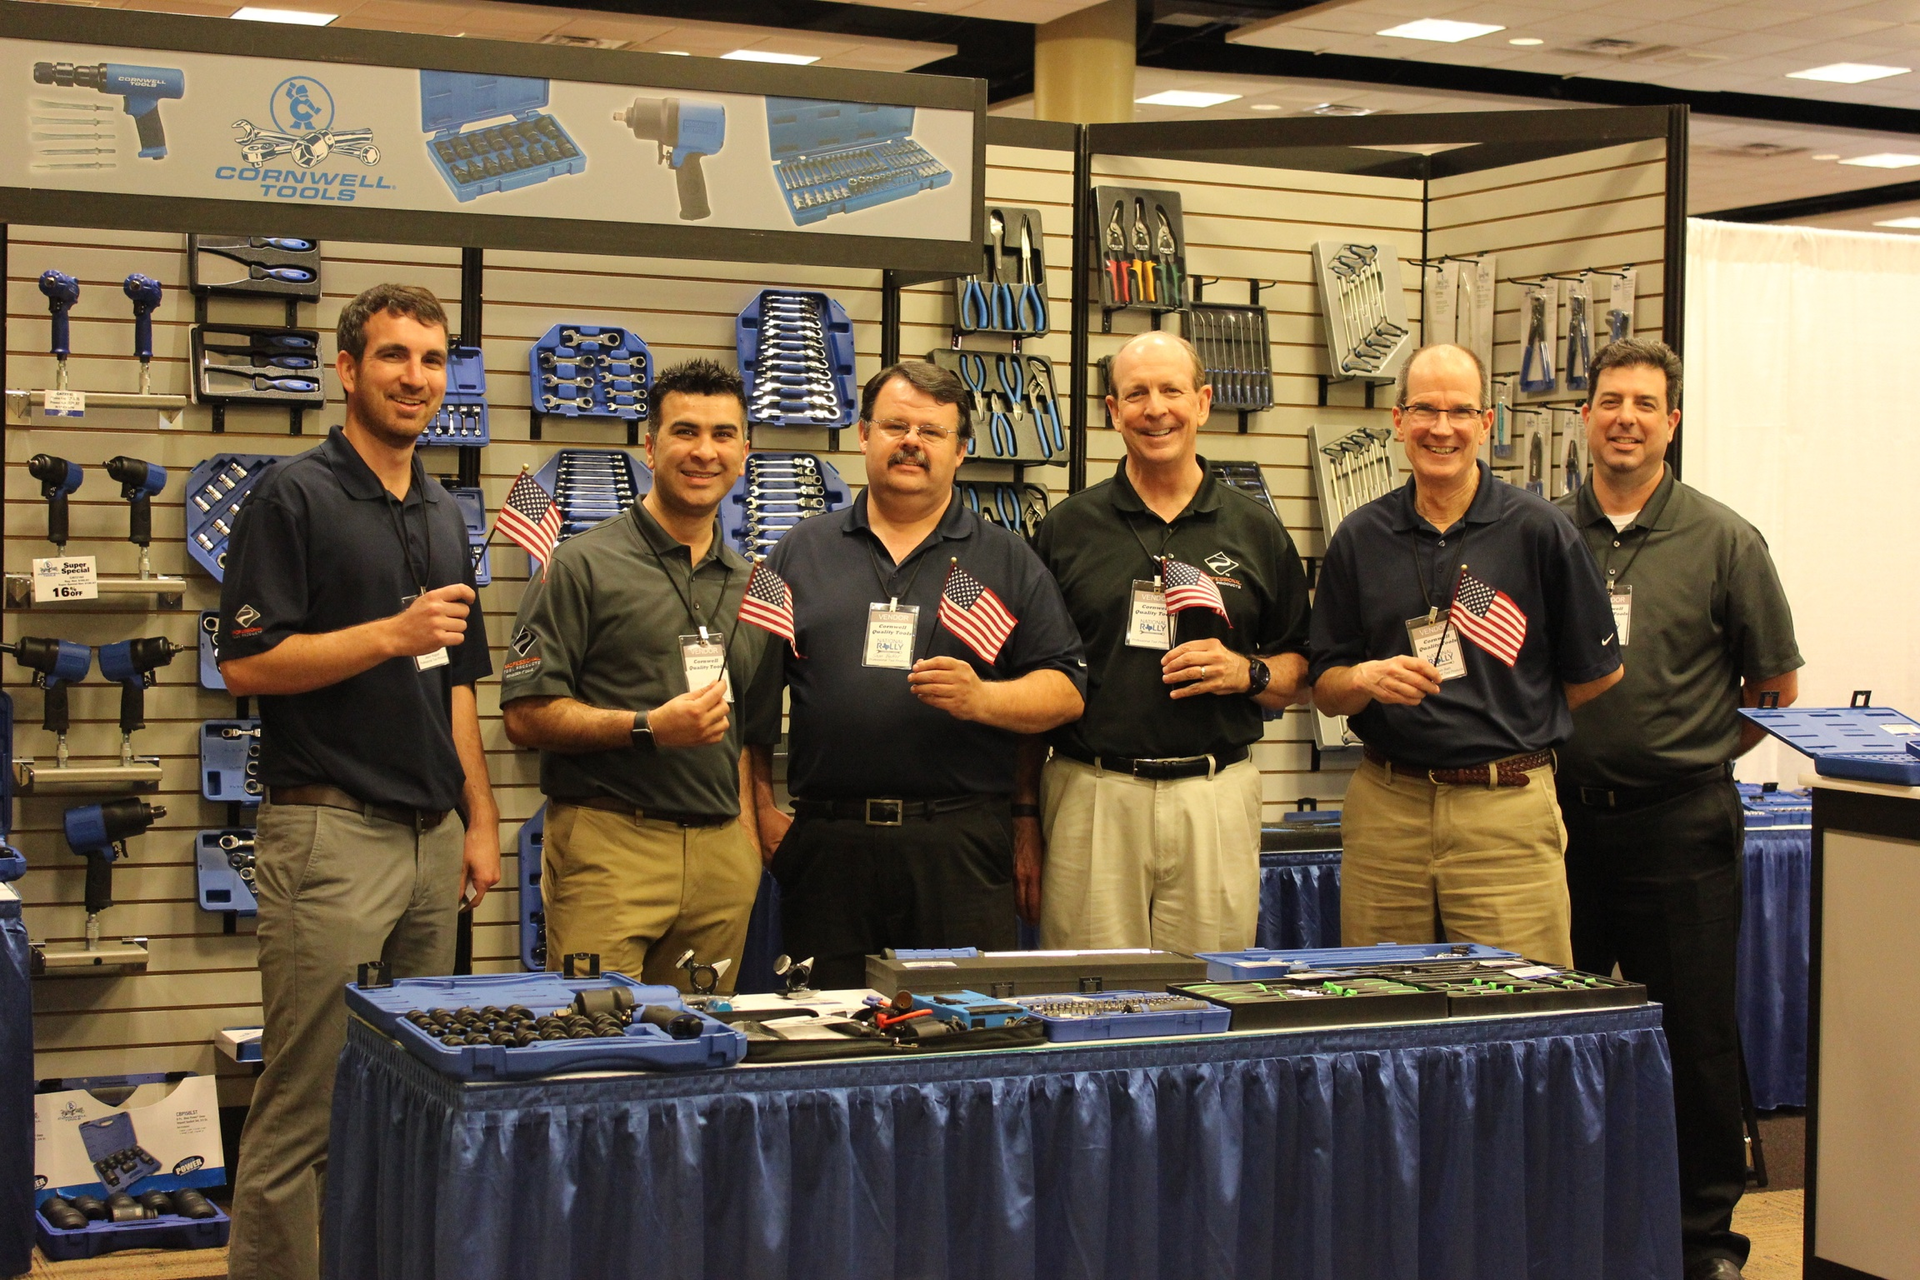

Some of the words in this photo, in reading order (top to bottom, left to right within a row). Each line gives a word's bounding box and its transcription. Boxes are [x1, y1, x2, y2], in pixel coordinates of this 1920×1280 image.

[118, 76, 166, 85] CORNWELL
[215, 166, 392, 190] CORNWELL
[260, 184, 357, 202] TOOLS
[61, 567, 90, 575] Special
[53, 587, 70, 598] 16
[879, 613, 909, 621] VENDOR
[1423, 633, 1450, 645] Cornwll
[175, 1158, 203, 1176] POWER
